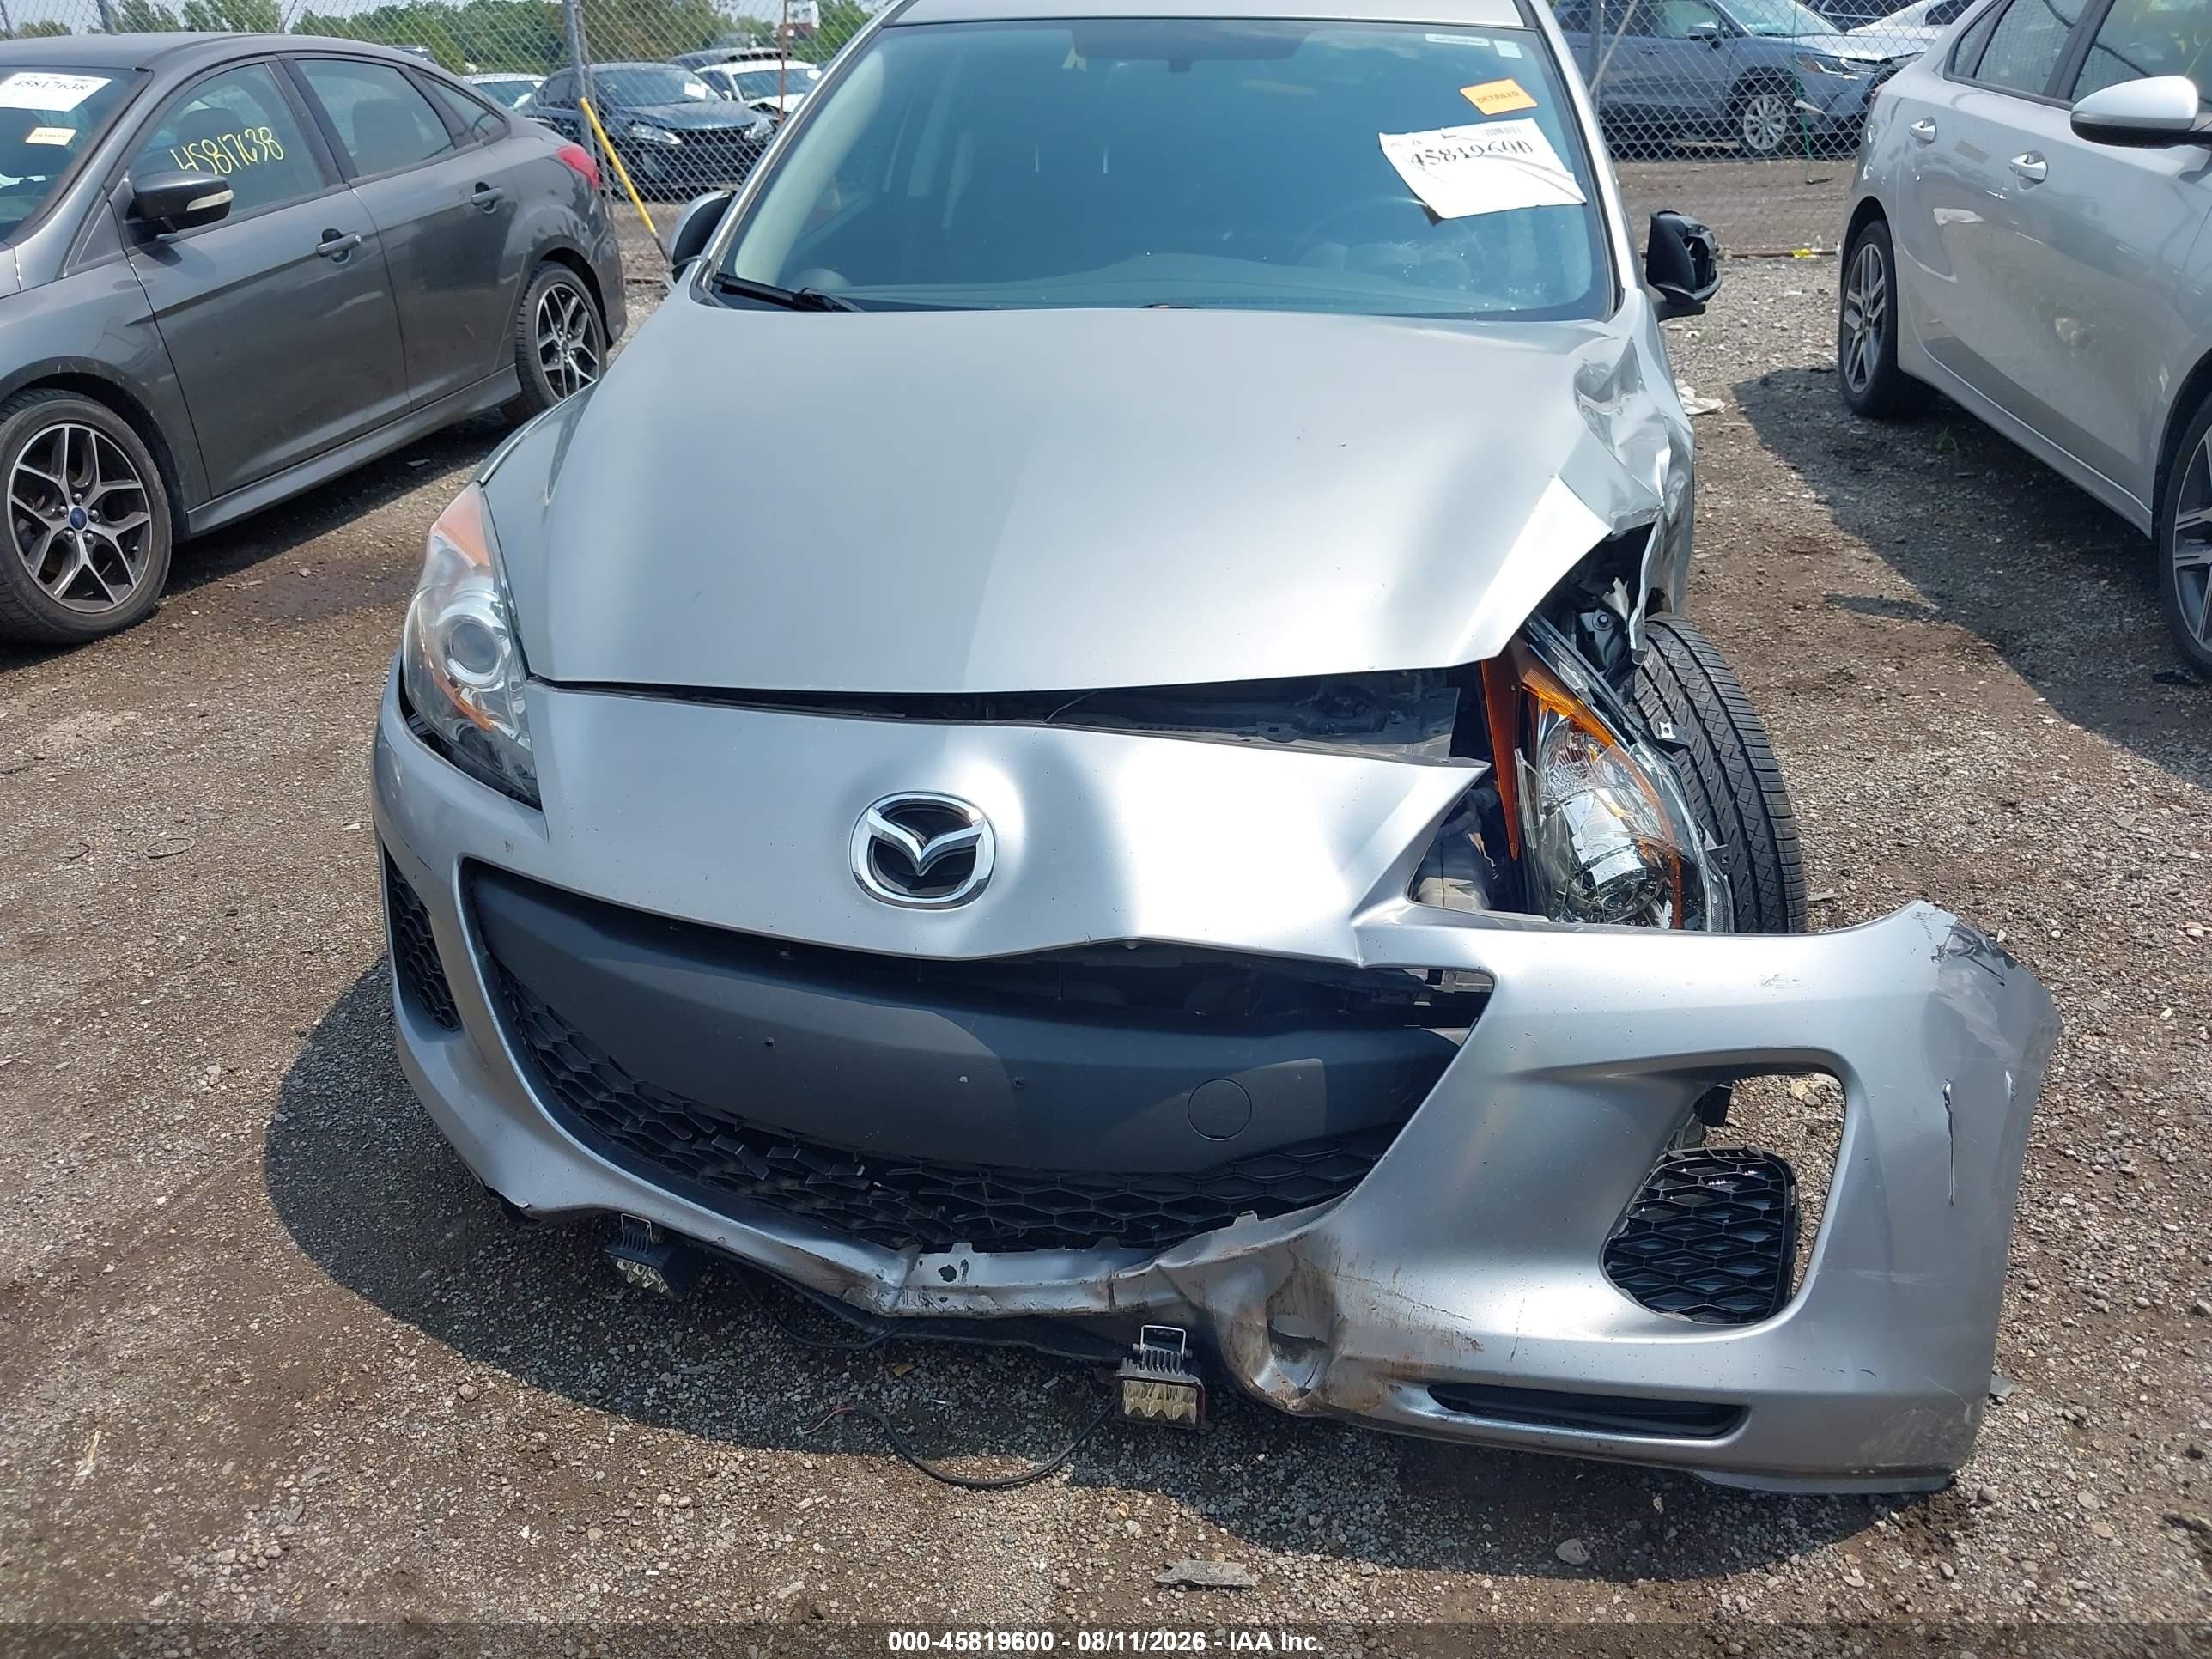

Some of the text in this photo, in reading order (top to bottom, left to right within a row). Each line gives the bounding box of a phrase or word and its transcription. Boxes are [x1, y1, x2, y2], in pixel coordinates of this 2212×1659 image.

[1476, 90, 1520, 104] DETAILED
[170, 126, 284, 175] 45817638
[1411, 140, 1533, 167] 45819600
